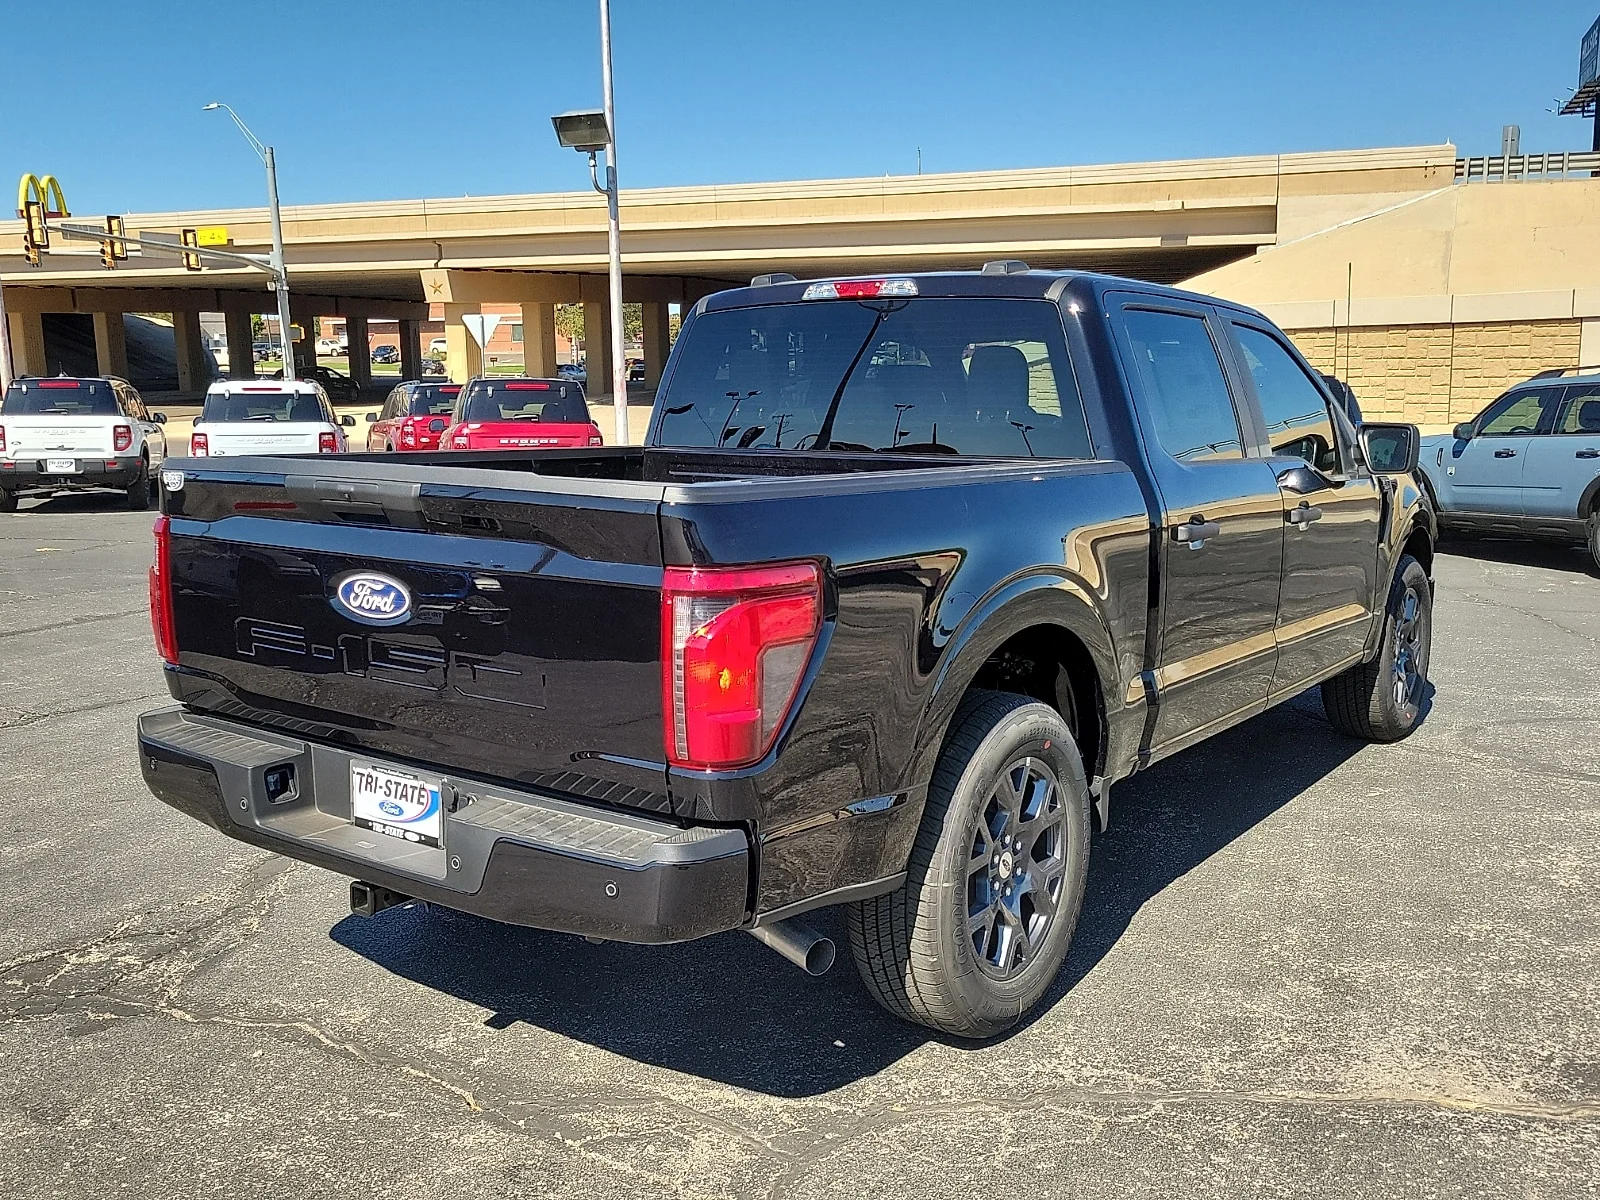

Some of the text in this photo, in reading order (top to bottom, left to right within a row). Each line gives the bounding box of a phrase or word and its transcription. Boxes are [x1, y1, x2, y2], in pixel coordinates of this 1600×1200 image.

[350, 580, 396, 613] Ford
[356, 772, 425, 806] TRI-STATE
[381, 801, 401, 815] Ford
[372, 822, 406, 839] TRI-STATE
